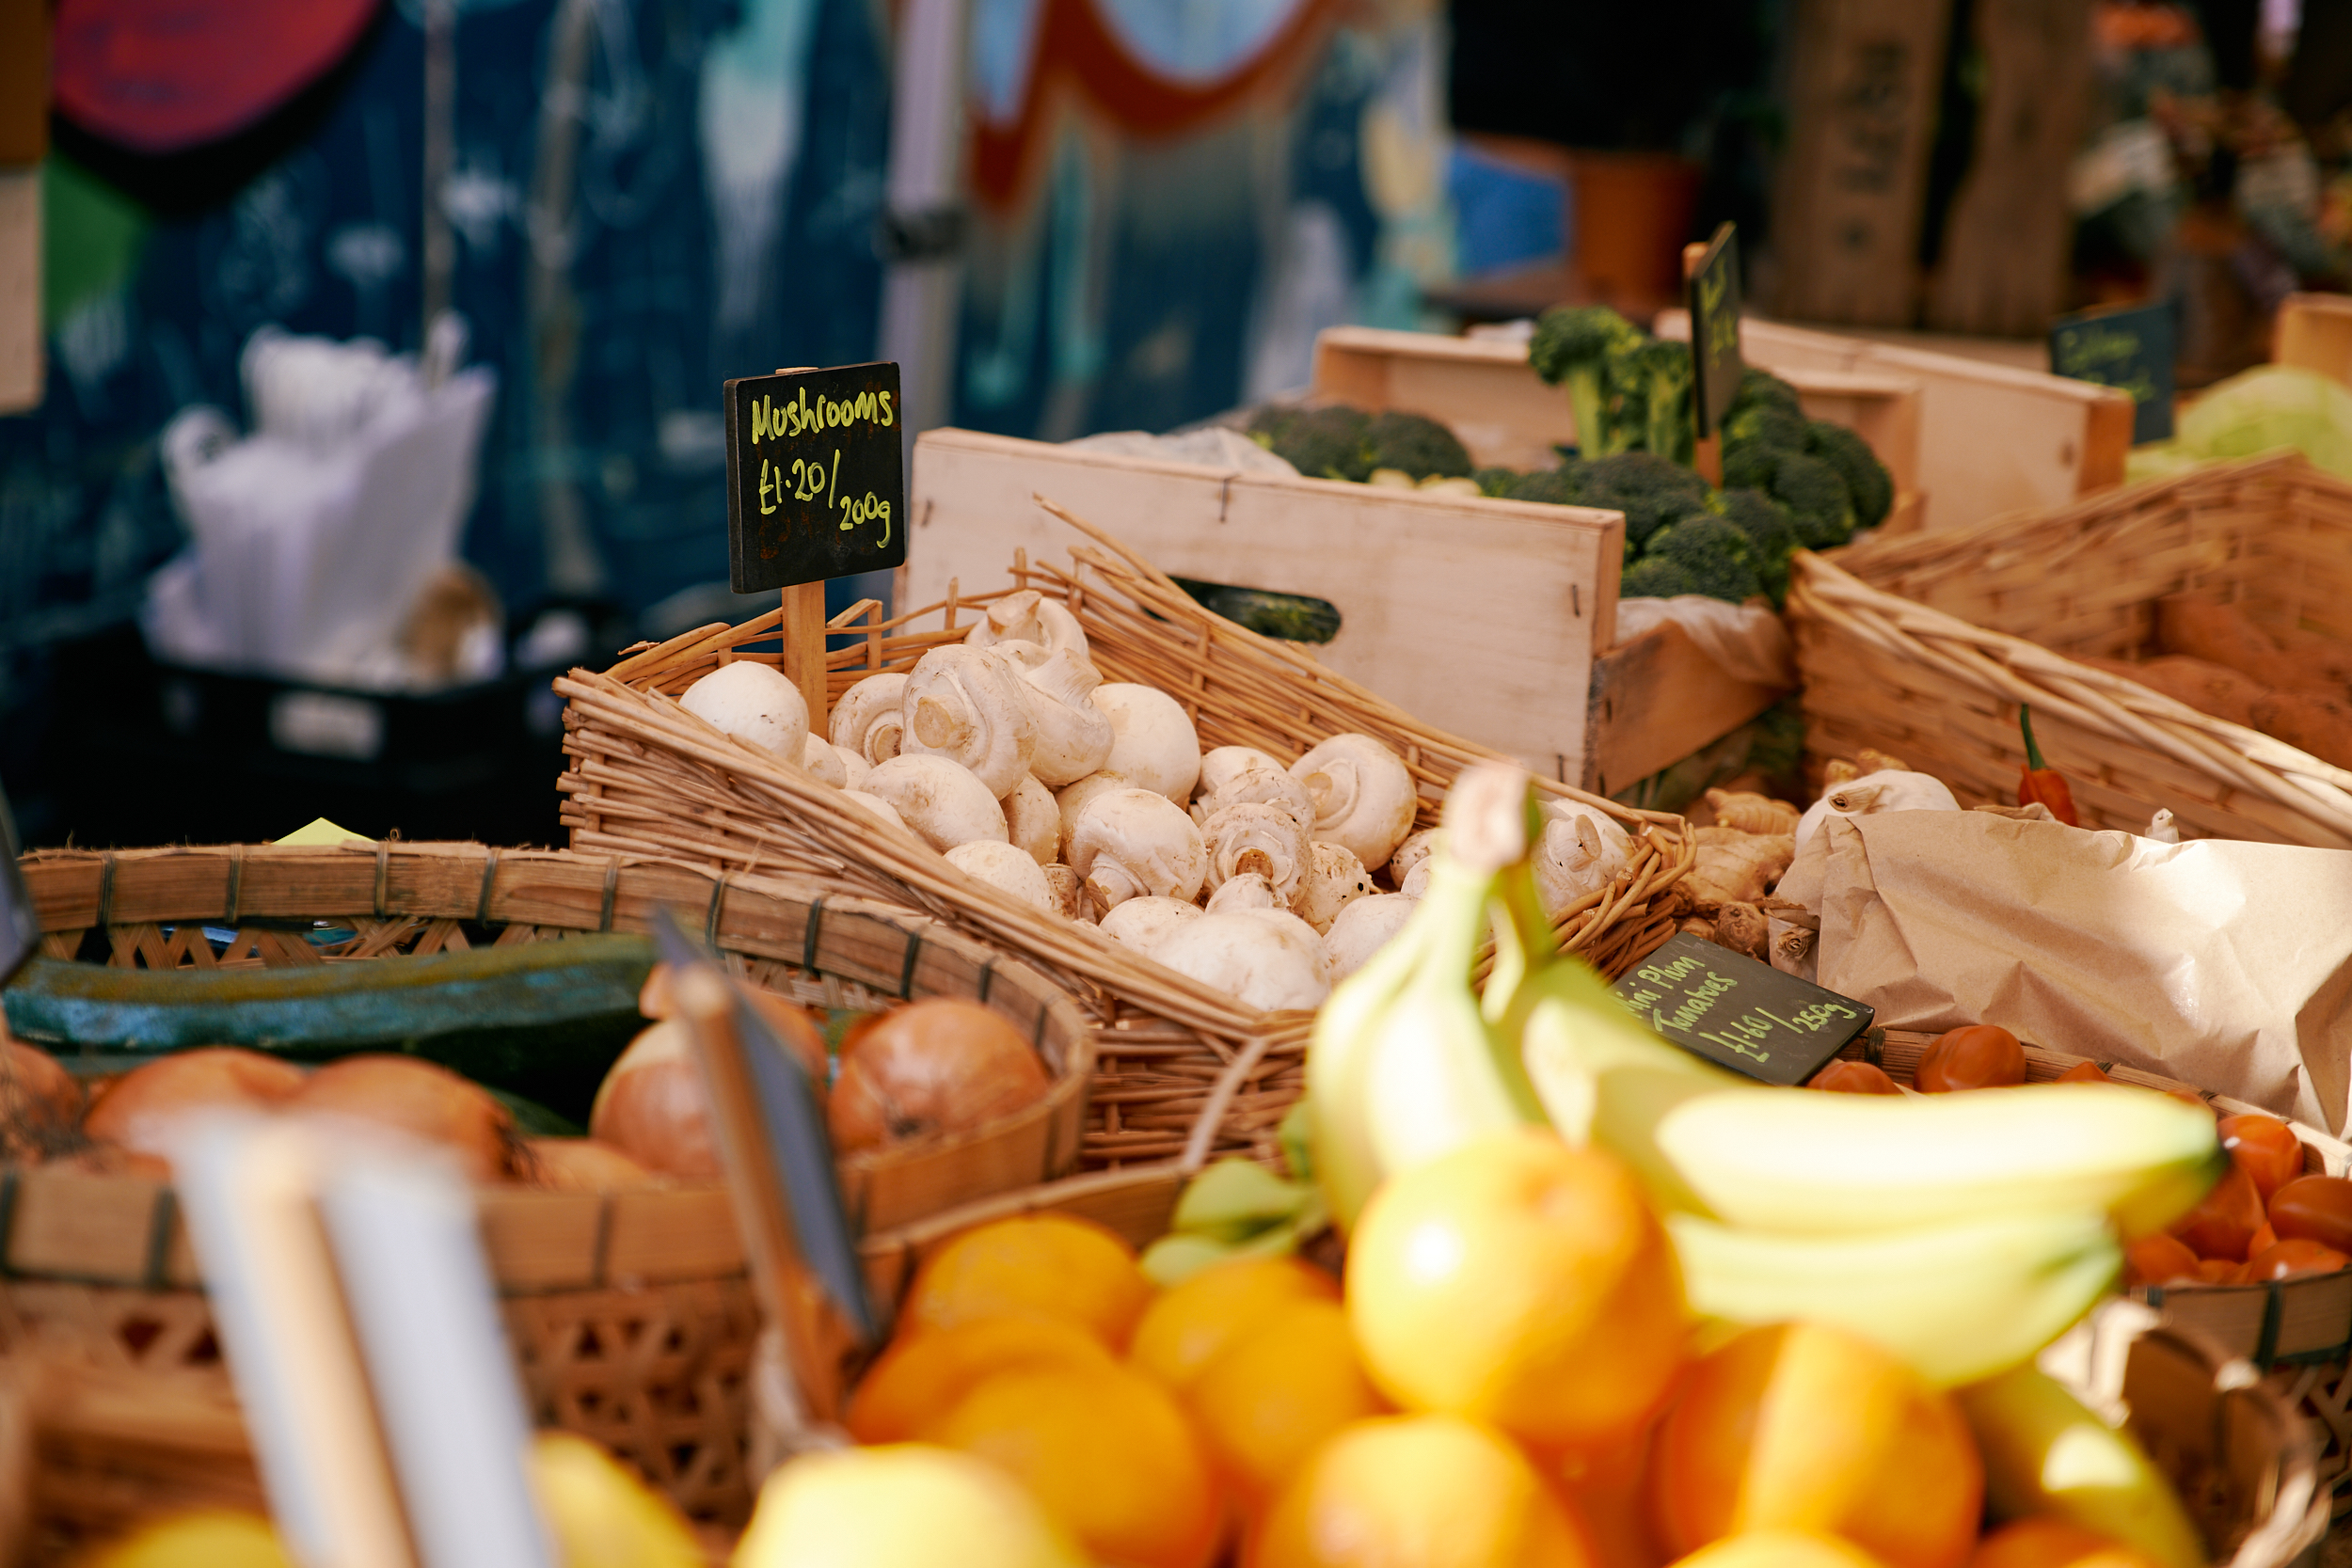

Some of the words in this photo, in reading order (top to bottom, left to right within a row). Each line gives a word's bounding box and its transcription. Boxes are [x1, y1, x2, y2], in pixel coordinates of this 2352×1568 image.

[753, 387, 893, 444] Mushrooms
[1638, 956, 1706, 990] Plum
[1653, 972, 1738, 1033] Tomatoes
